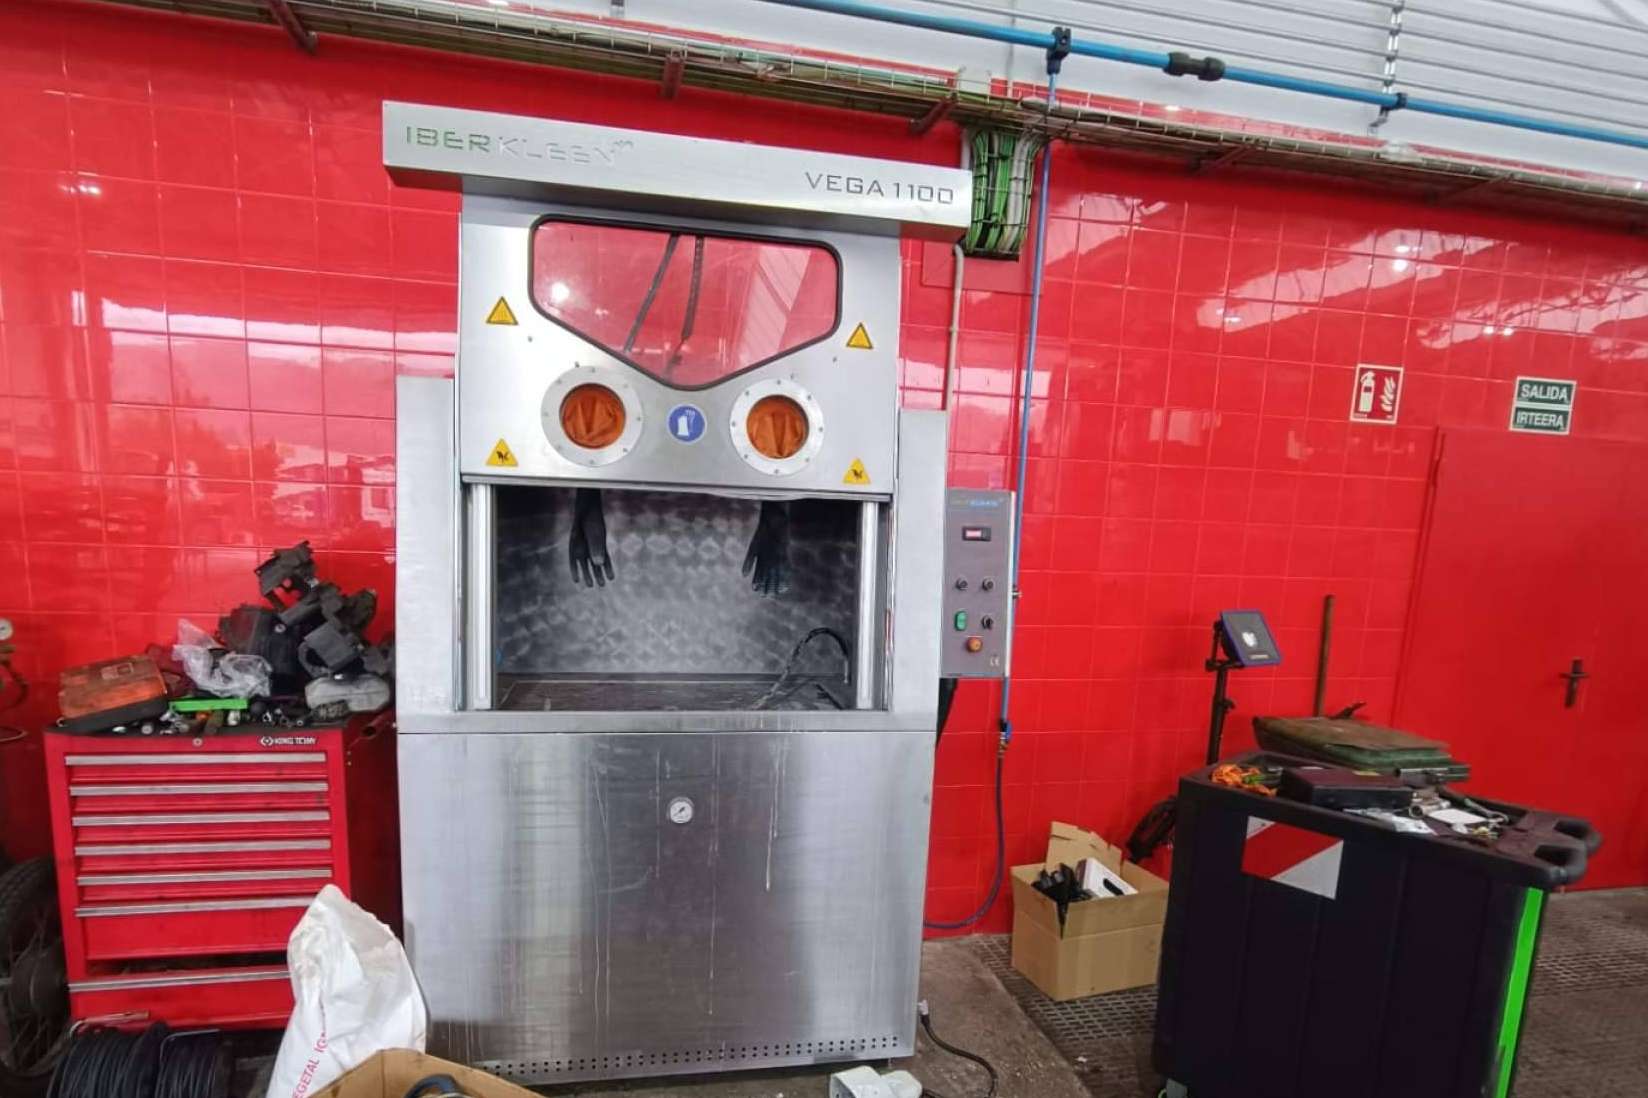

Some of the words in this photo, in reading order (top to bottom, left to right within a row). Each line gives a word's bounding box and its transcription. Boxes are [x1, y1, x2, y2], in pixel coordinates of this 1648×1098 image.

[805, 171, 885, 198] VEGA
[892, 181, 954, 204] 1100
[1521, 383, 1569, 404] SALIDA
[1516, 411, 1564, 430] IRTEERA
[292, 1058, 320, 1098] EGETAL
